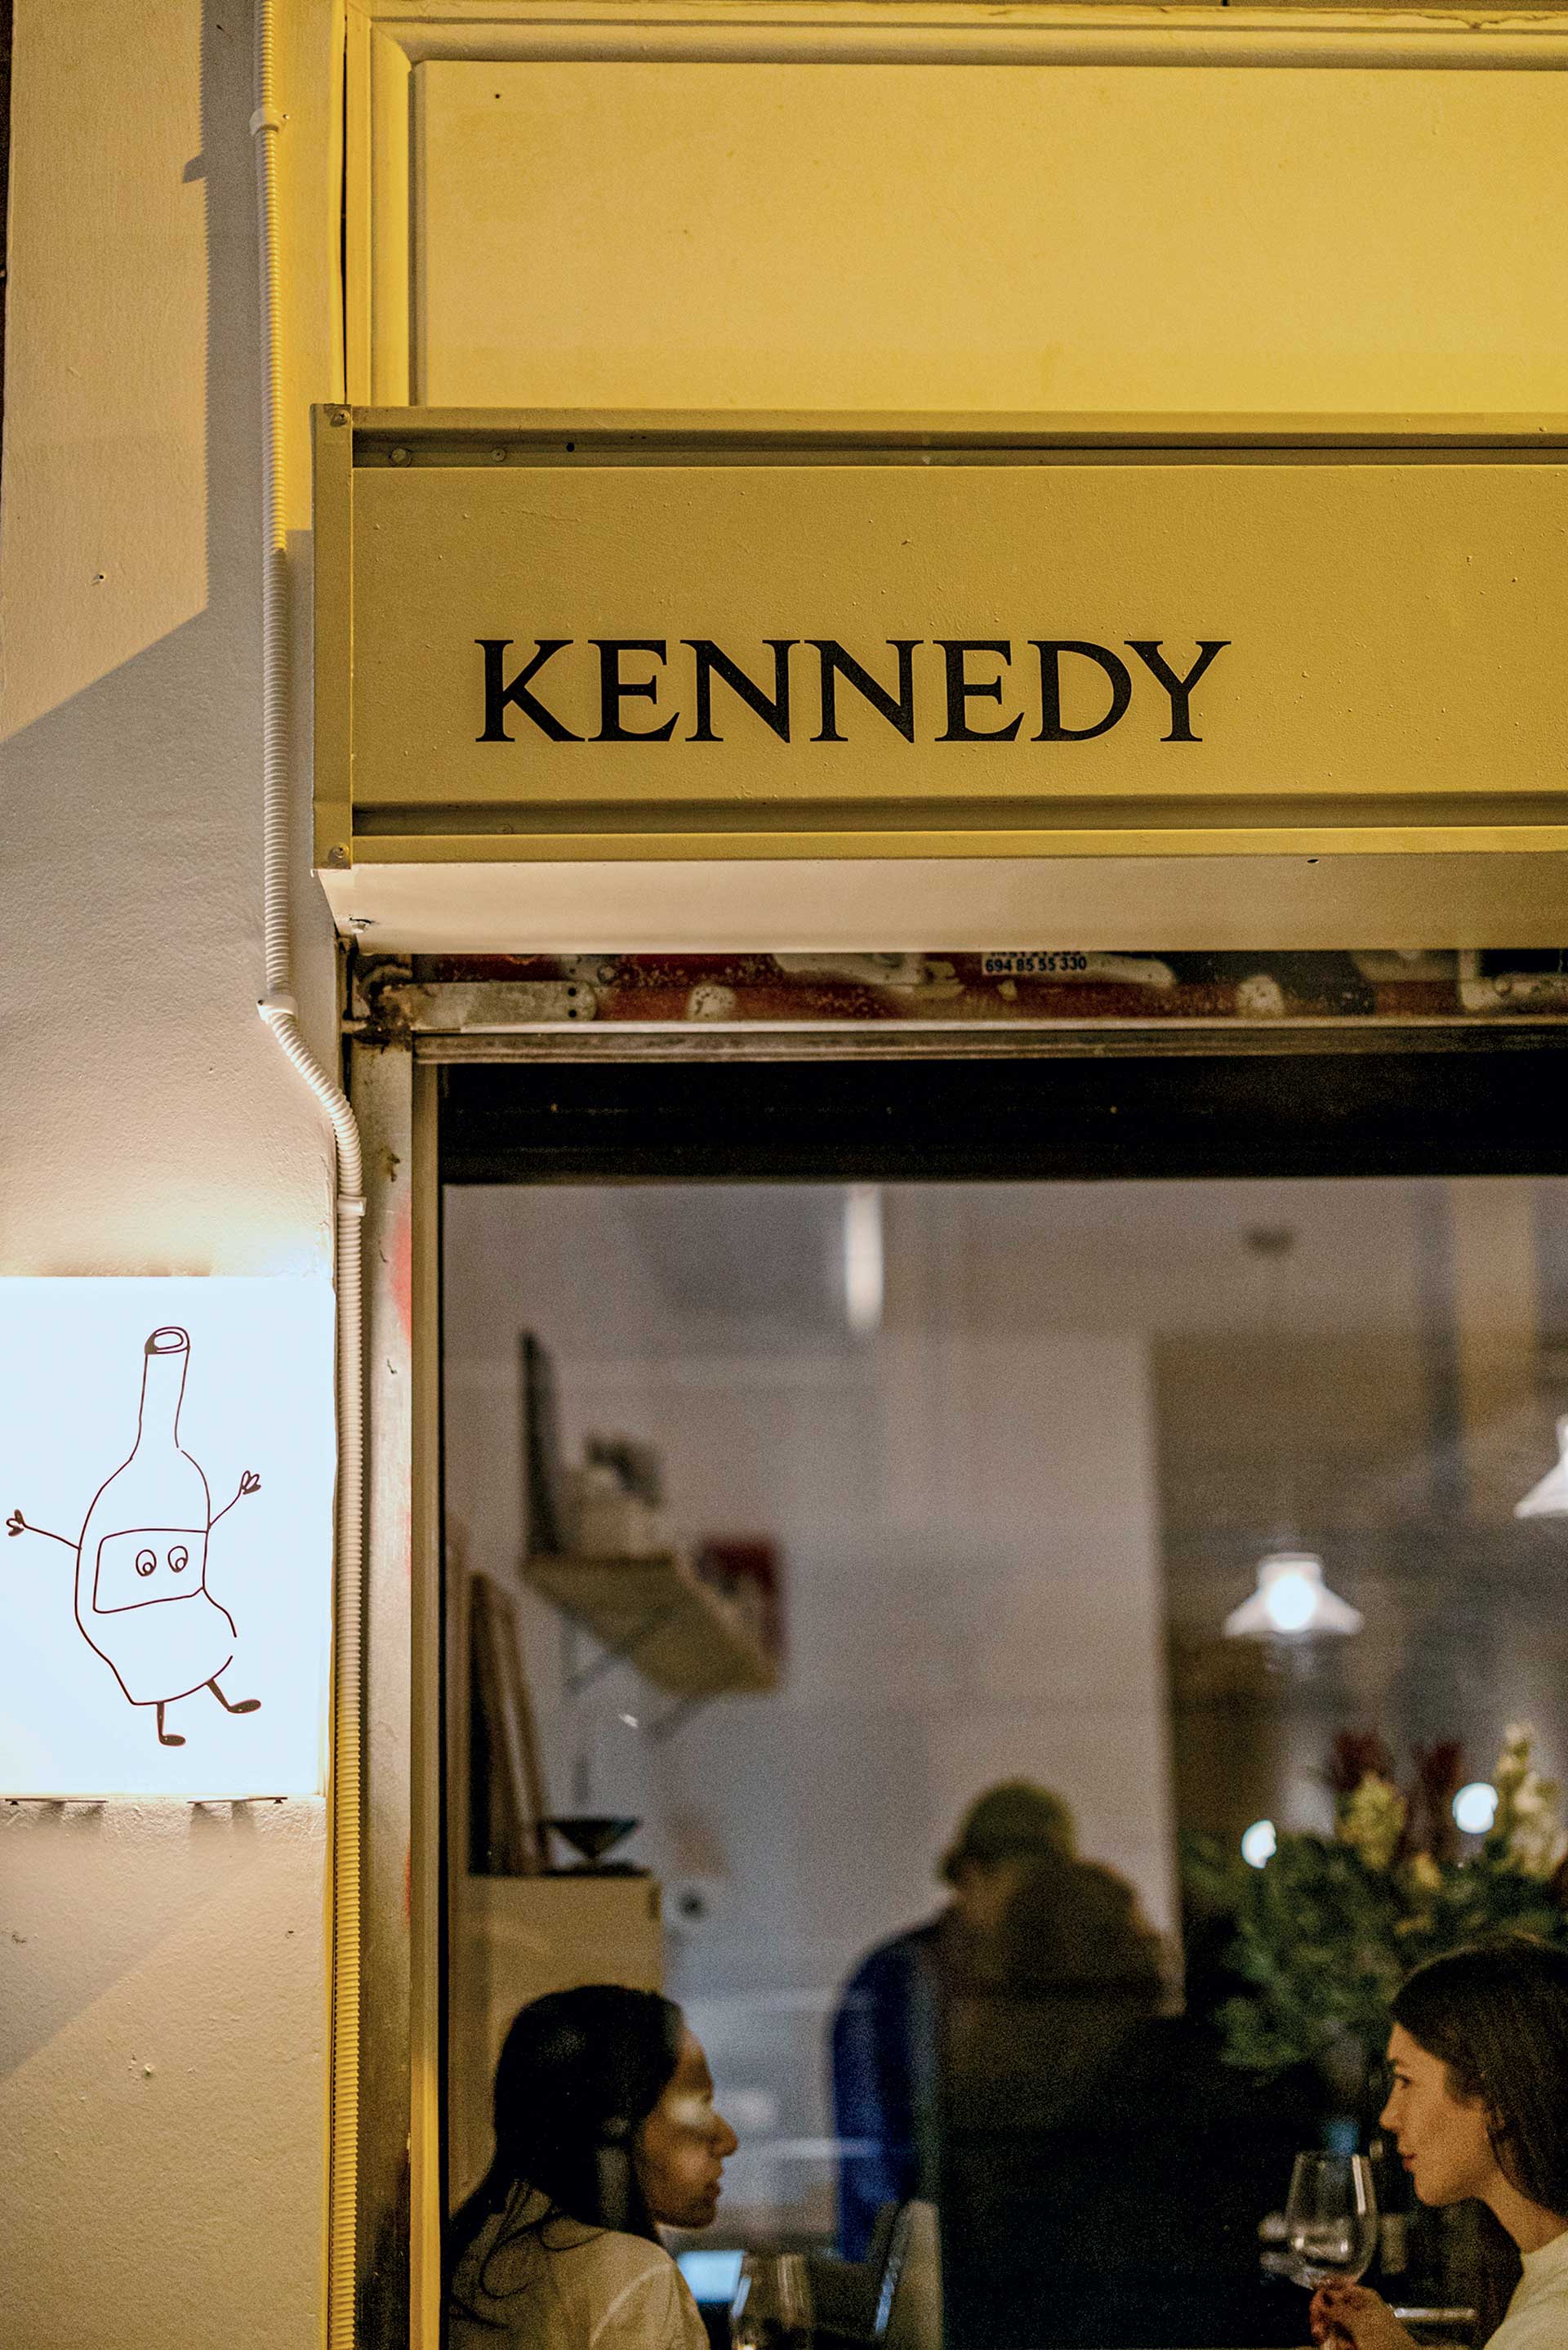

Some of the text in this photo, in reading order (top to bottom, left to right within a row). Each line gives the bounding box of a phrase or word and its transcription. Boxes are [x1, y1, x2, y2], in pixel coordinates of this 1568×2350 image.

[474, 639, 1232, 742] KENNEDY
[985, 956, 1087, 972] 694 85 55 330
